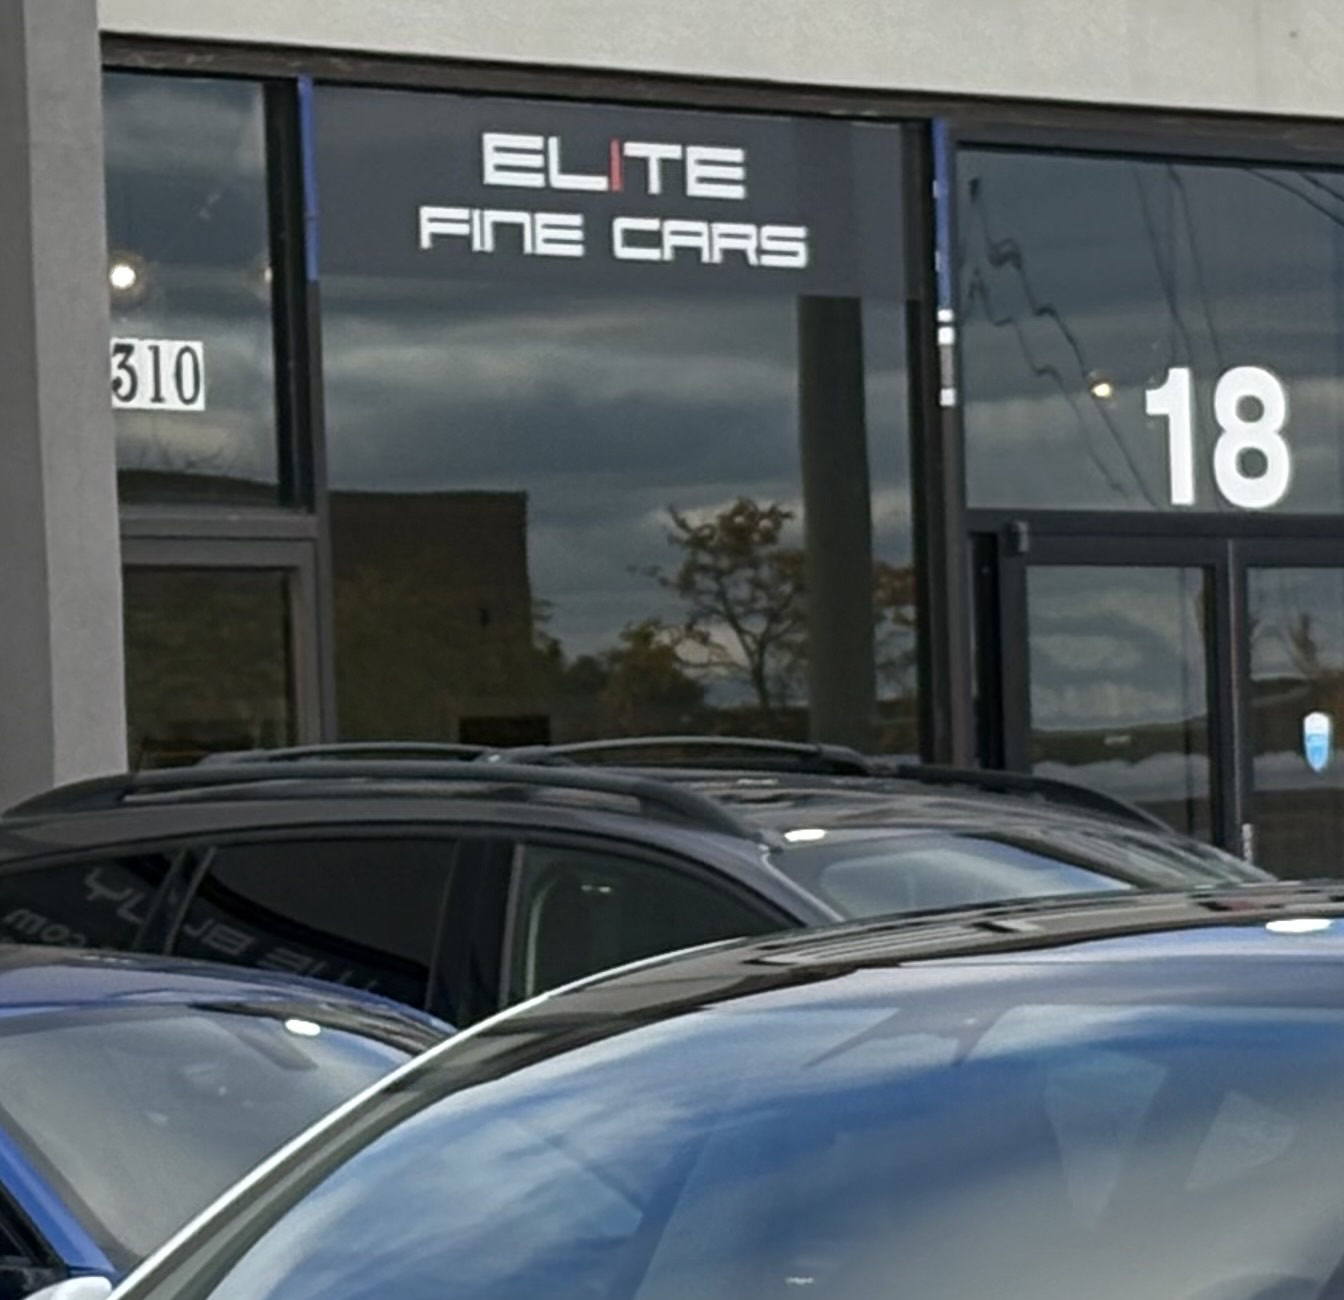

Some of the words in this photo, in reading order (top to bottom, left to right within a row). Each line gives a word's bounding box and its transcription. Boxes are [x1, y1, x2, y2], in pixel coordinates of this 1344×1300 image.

[482, 132, 746, 200] ELITE
[419, 206, 585, 257] FINE
[612, 217, 807, 268] CARS
[112, 343, 201, 406] 310
[1145, 366, 1291, 509] 18
